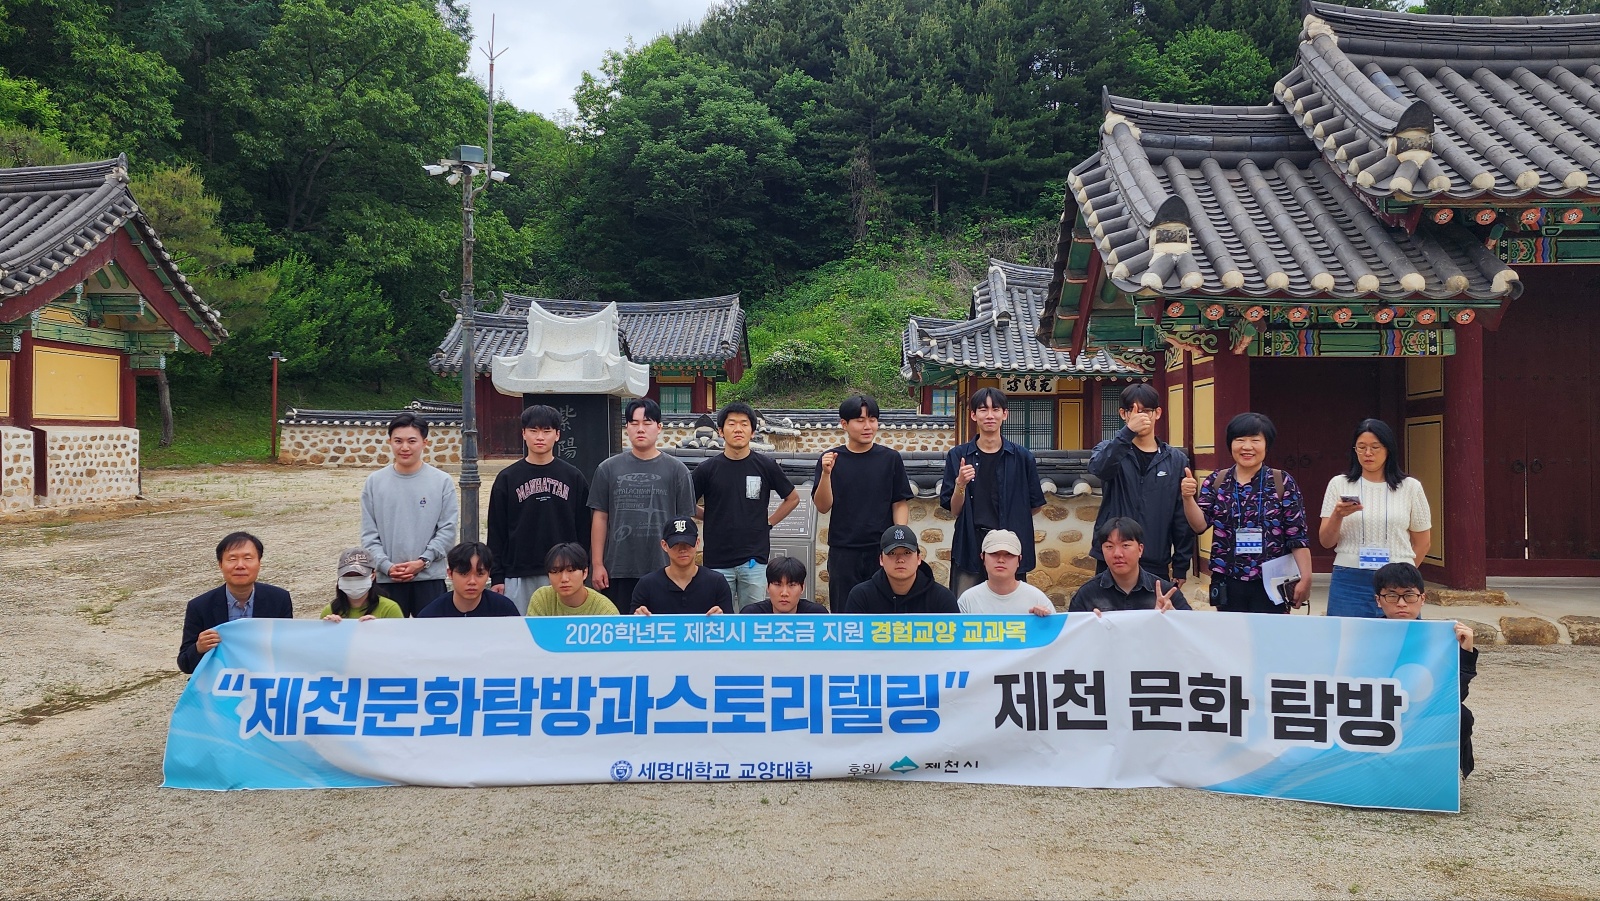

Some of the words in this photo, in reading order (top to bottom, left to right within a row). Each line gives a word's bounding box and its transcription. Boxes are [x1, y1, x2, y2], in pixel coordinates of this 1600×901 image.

[515, 477, 570, 502] MANHATTAN
[565, 622, 677, 645] 2026학년도
[684, 621, 746, 643] 제천시
[753, 621, 816, 643] 보조금
[822, 621, 864, 643] 지원
[871, 620, 957, 643] 경험교양
[962, 621, 1026, 643] 교과목
[994, 669, 1109, 732] 제천
[1129, 670, 1250, 737] 문화
[1271, 678, 1403, 747] 탐방
[638, 761, 731, 781] 세명대학교
[738, 761, 813, 780] 교양대학
[848, 763, 883, 777] 후원/
[925, 759, 979, 774] 제천시
